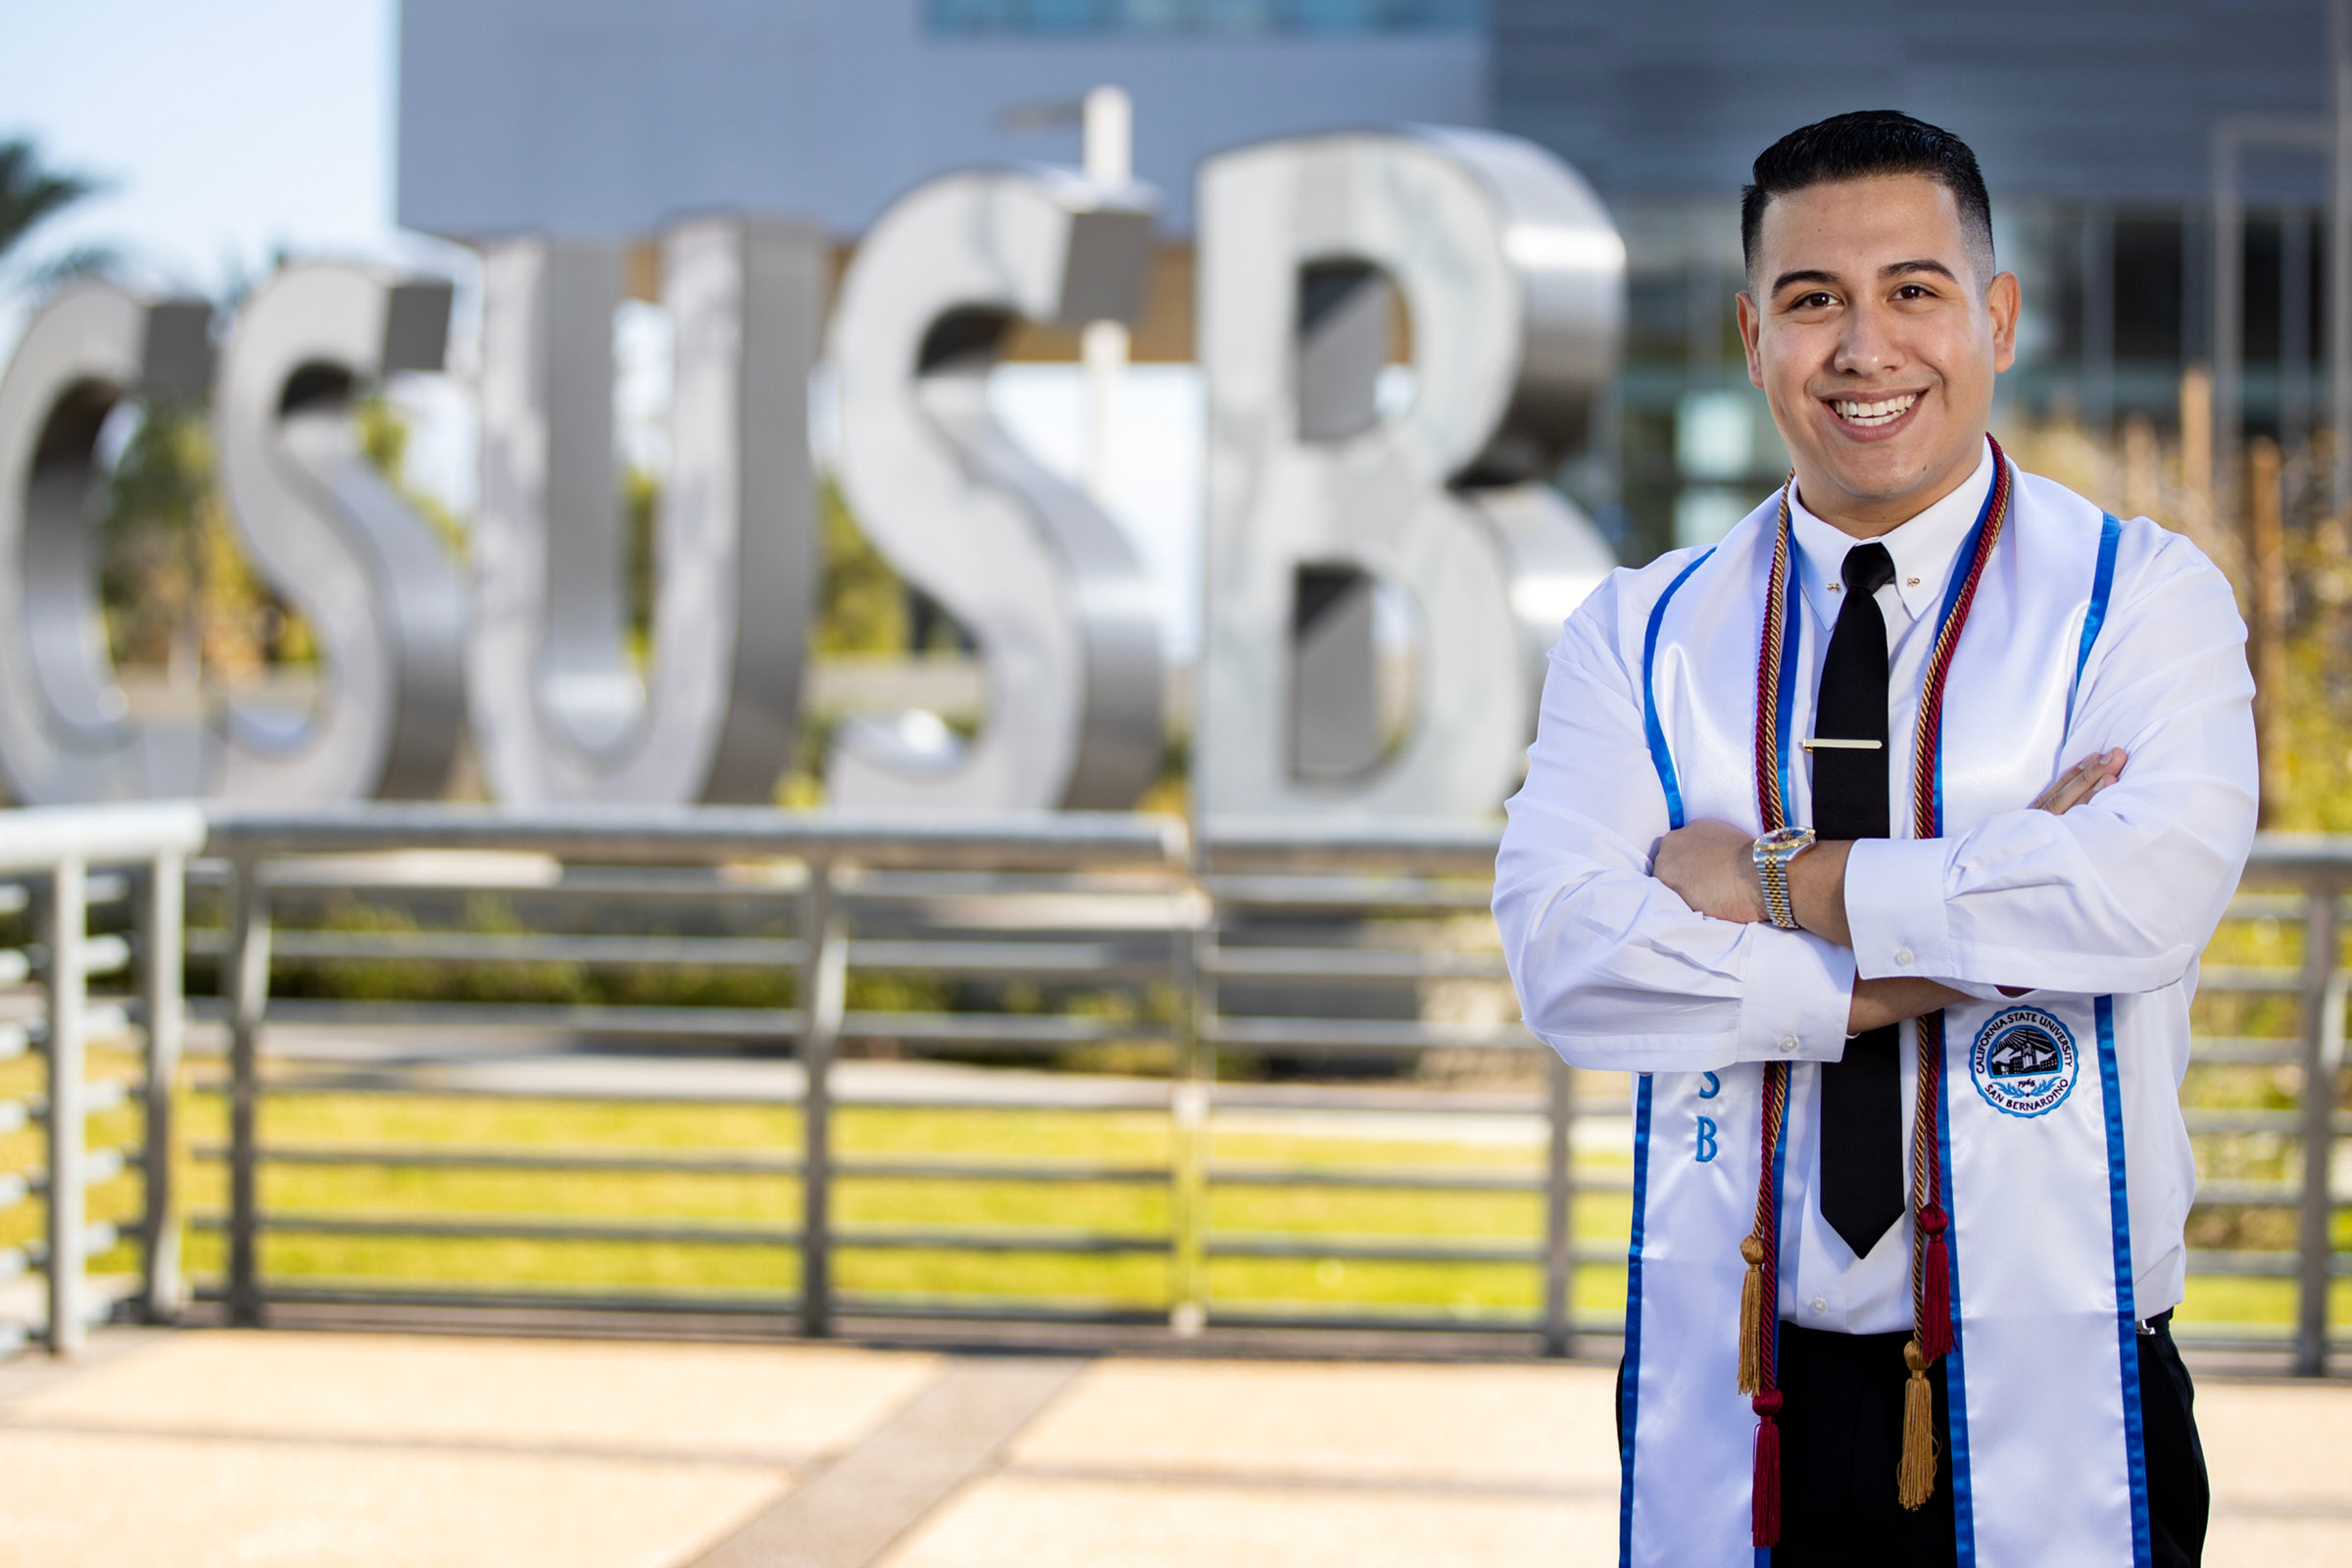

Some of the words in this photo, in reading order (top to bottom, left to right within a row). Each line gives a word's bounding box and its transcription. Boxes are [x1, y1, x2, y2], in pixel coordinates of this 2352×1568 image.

[0, 127, 1627, 815] CSUSB
[1976, 1019, 2008, 1074] CALIFORNIA
[2007, 1012, 2037, 1023] STATE
[2039, 1016, 2073, 1067] UNIVERSITY
[1984, 1084, 2004, 1102] SAN
[2006, 1078, 2069, 1111] BERNARDINO
[2018, 1078, 2035, 1088] 1965
